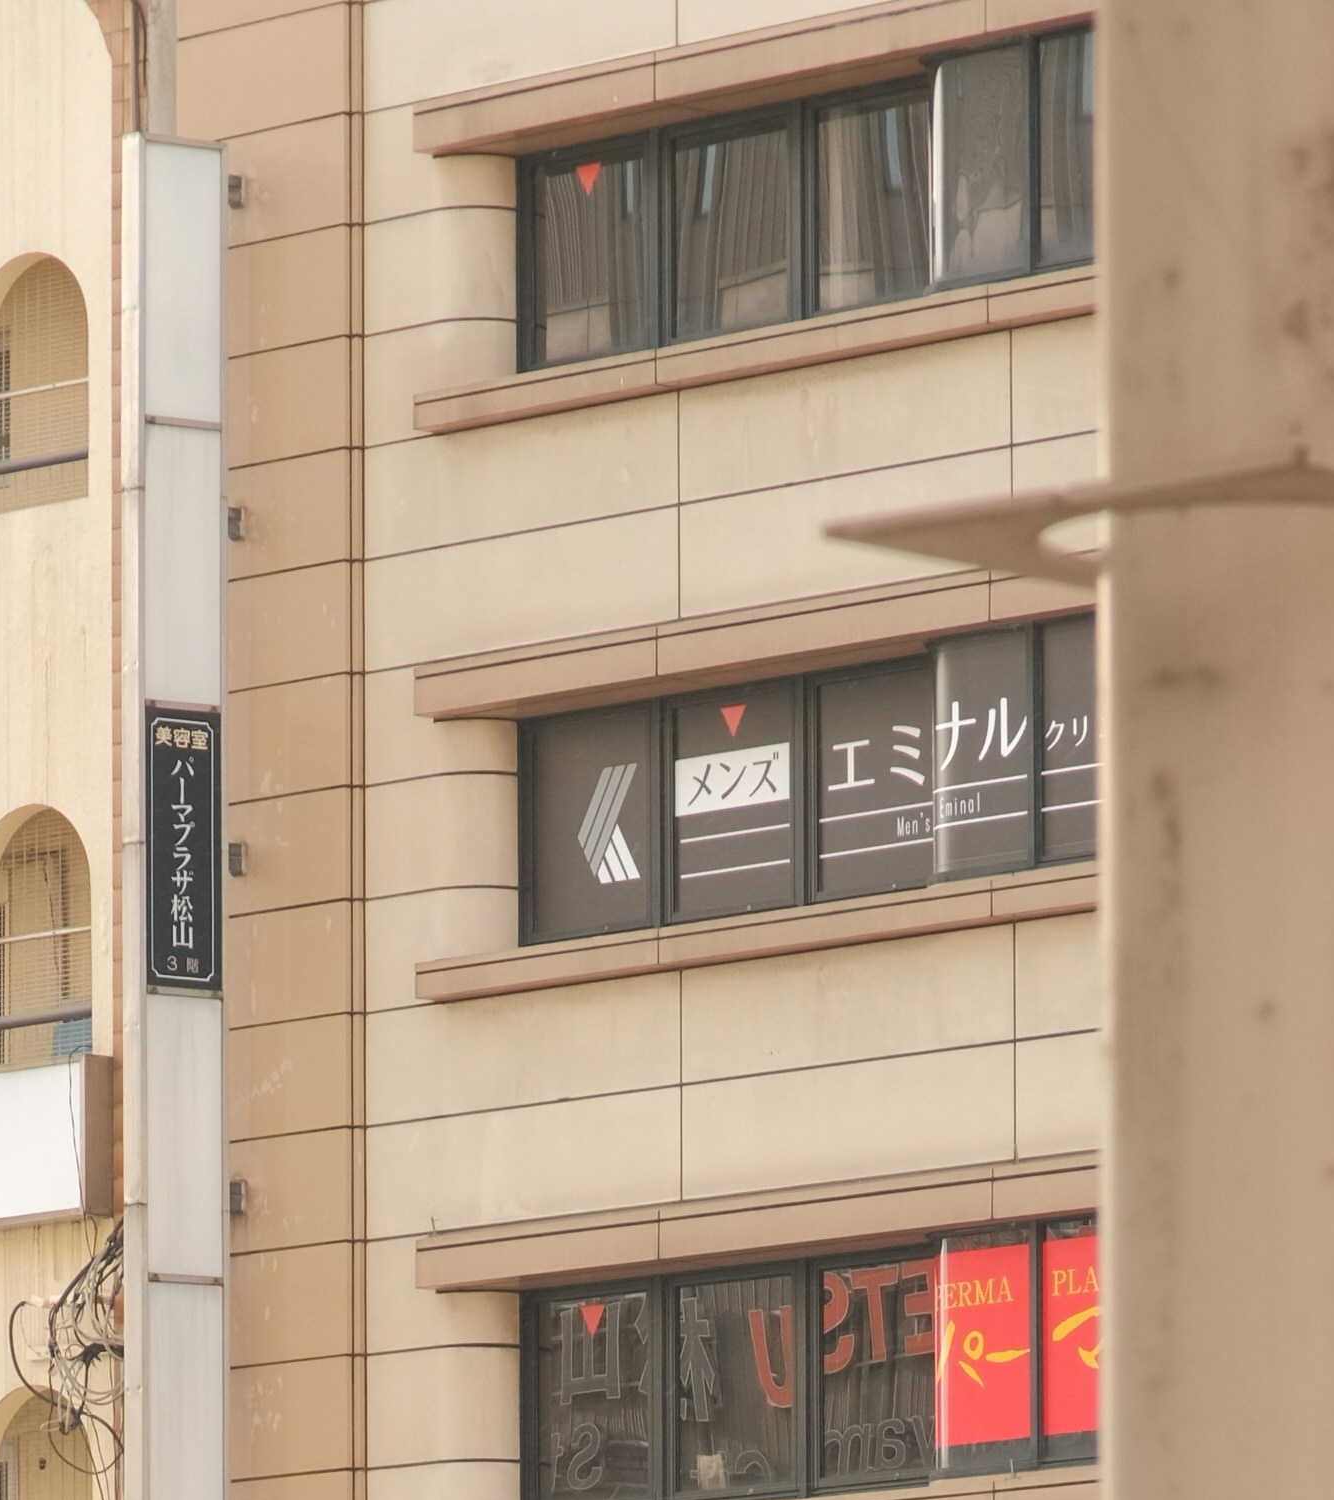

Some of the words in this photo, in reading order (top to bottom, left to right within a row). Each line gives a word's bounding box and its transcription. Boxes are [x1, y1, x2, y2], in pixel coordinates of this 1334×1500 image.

[155, 726, 208, 750] 美容室
[687, 751, 780, 808] メンズ
[827, 697, 1027, 792] エミナル
[896, 813, 931, 839] Men's
[939, 792, 982, 819] Eminal
[170, 756, 195, 949] パーマプラザ松山
[1052, 1266, 1101, 1297] PLA
